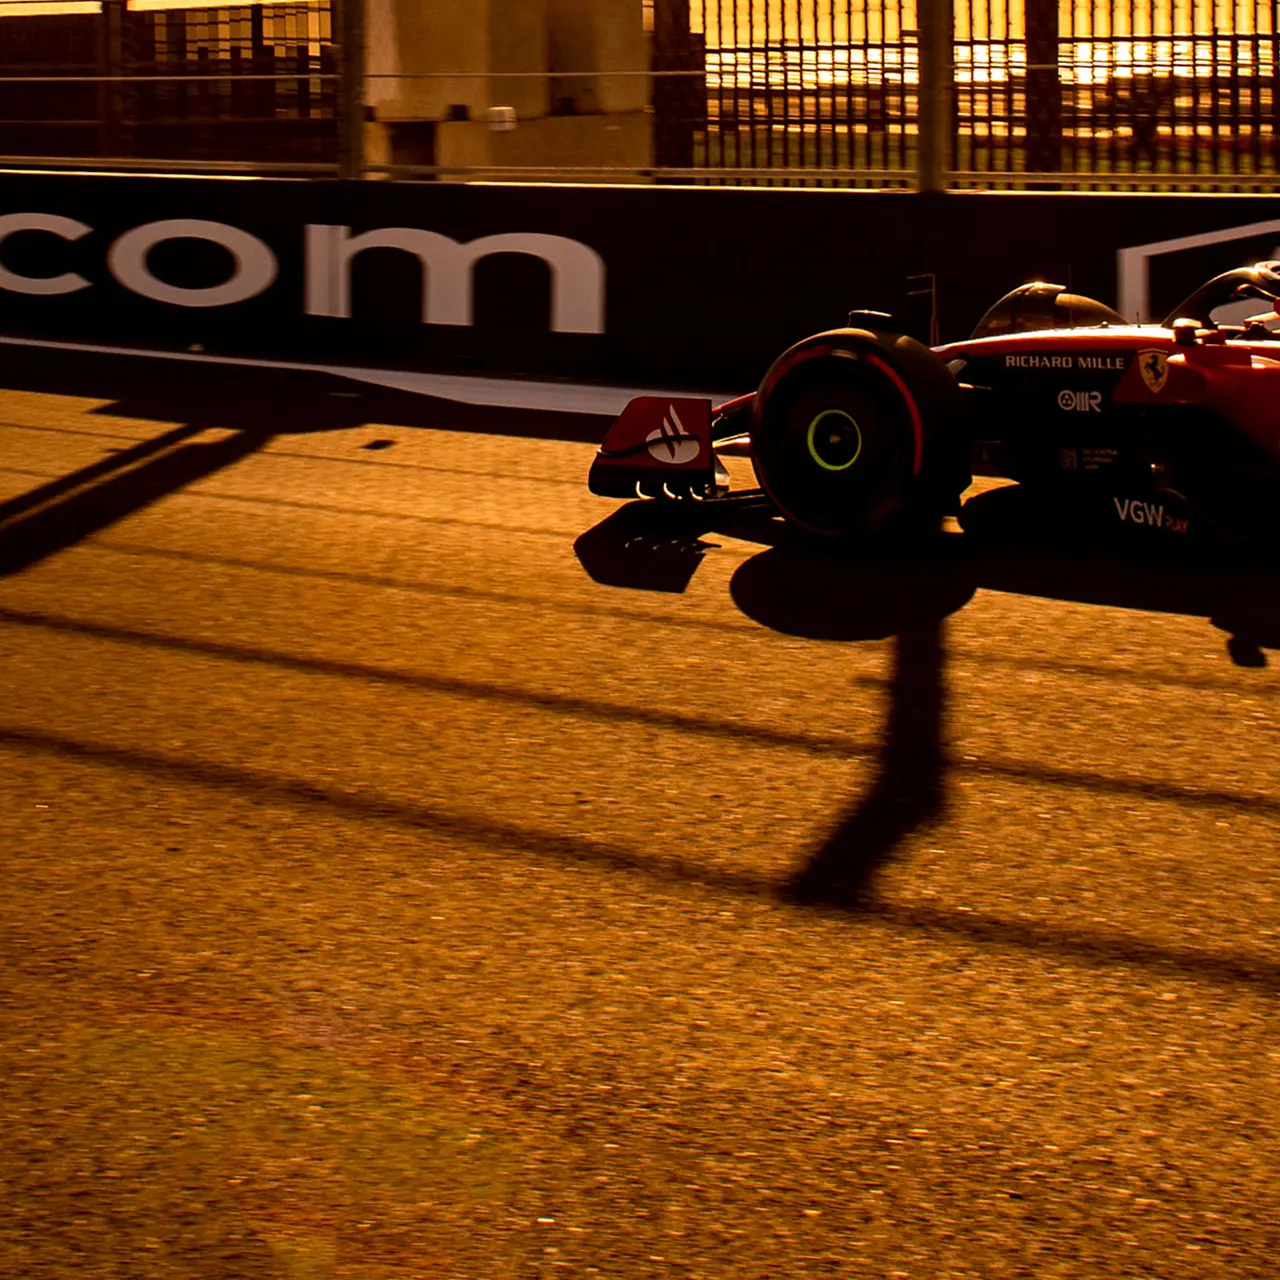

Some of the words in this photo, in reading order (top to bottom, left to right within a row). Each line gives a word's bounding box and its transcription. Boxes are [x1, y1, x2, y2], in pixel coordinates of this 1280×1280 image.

[1005, 355, 1073, 369] RICHARD
[1078, 356, 1125, 370] MILLE
[1112, 496, 1165, 528] VGW
